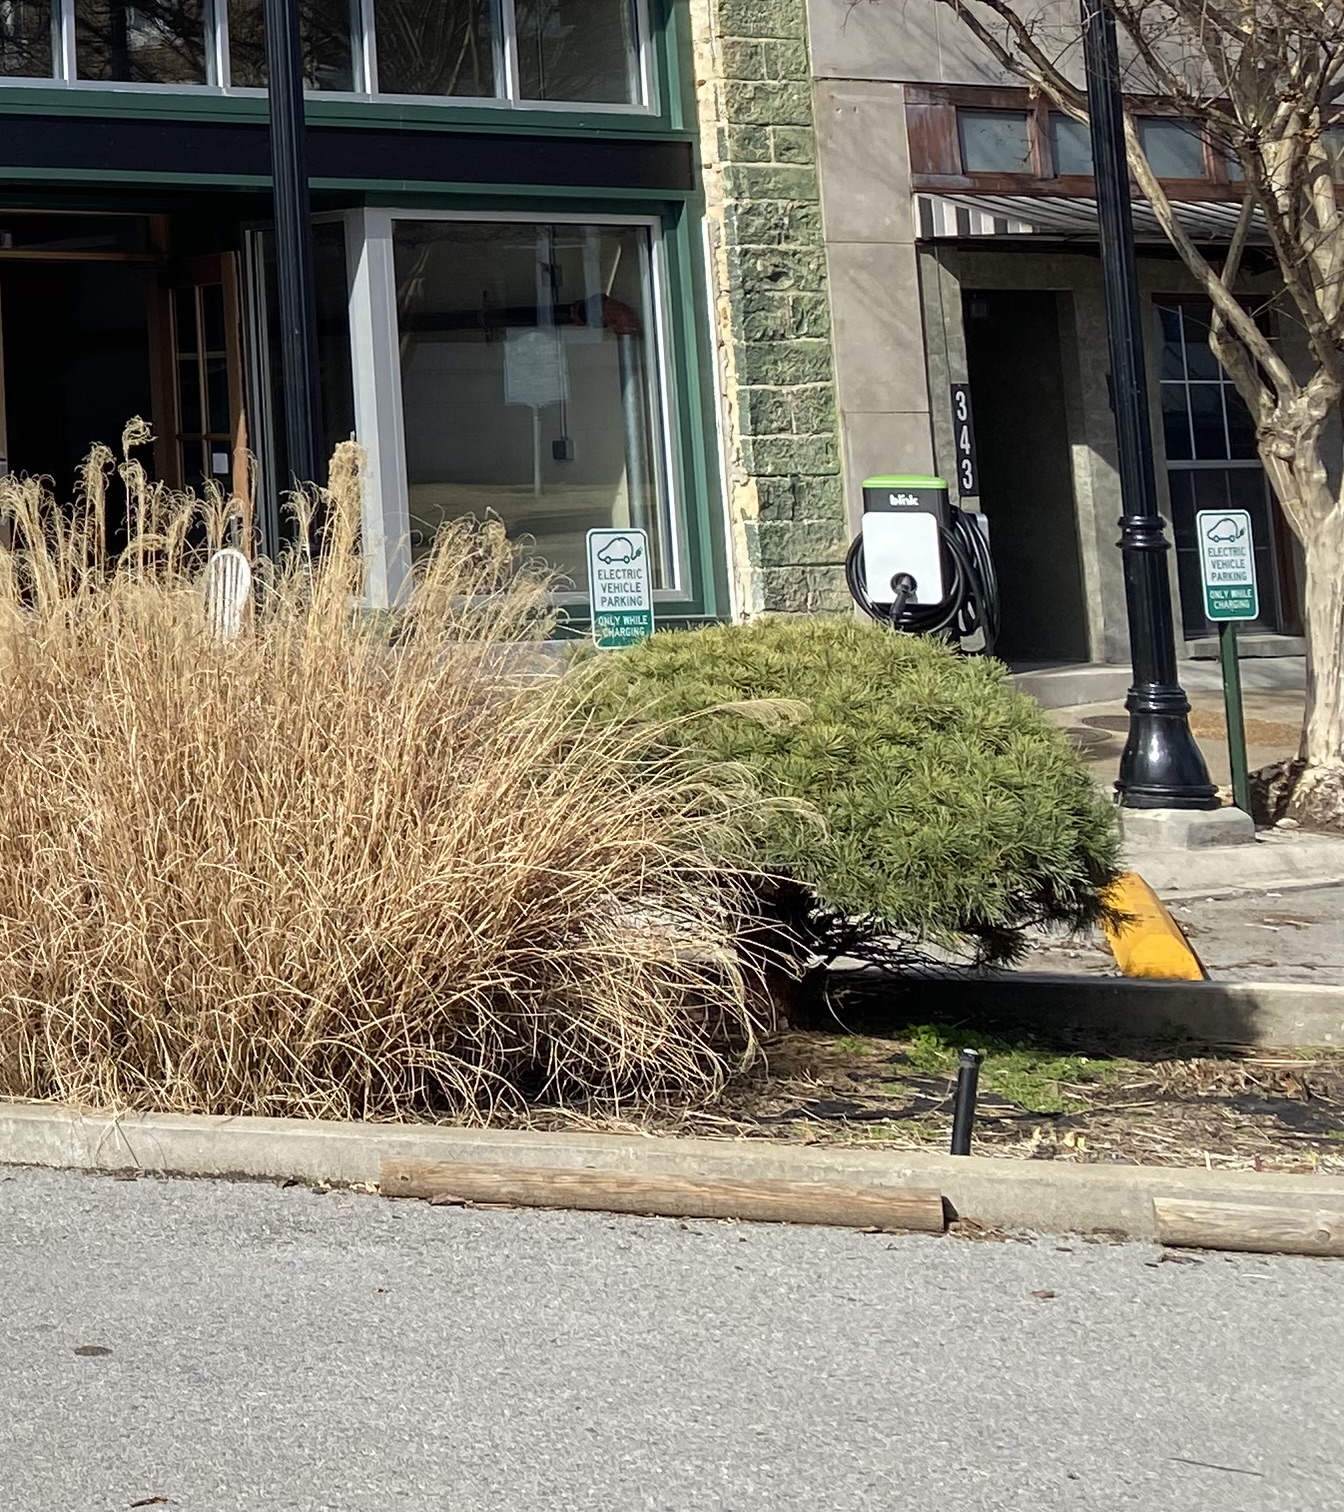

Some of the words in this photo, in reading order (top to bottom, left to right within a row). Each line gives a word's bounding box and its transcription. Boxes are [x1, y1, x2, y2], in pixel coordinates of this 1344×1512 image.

[955, 391, 973, 489] 343
[889, 493, 920, 506] blink
[1208, 546, 1246, 557] ELECTRIC
[1211, 558, 1245, 569] VEHICLE
[597, 568, 643, 581] ELECTRIC
[1211, 571, 1247, 582] PARKING
[600, 582, 642, 594] VEHICLE
[1209, 589, 1229, 599] ONLY
[1230, 588, 1253, 598] WHILE
[600, 595, 643, 607] PARKING
[1213, 599, 1251, 610] CHARGING
[597, 614, 621, 626] ONLY
[622, 614, 649, 626] WHILE
[602, 626, 645, 637] CHARGING
